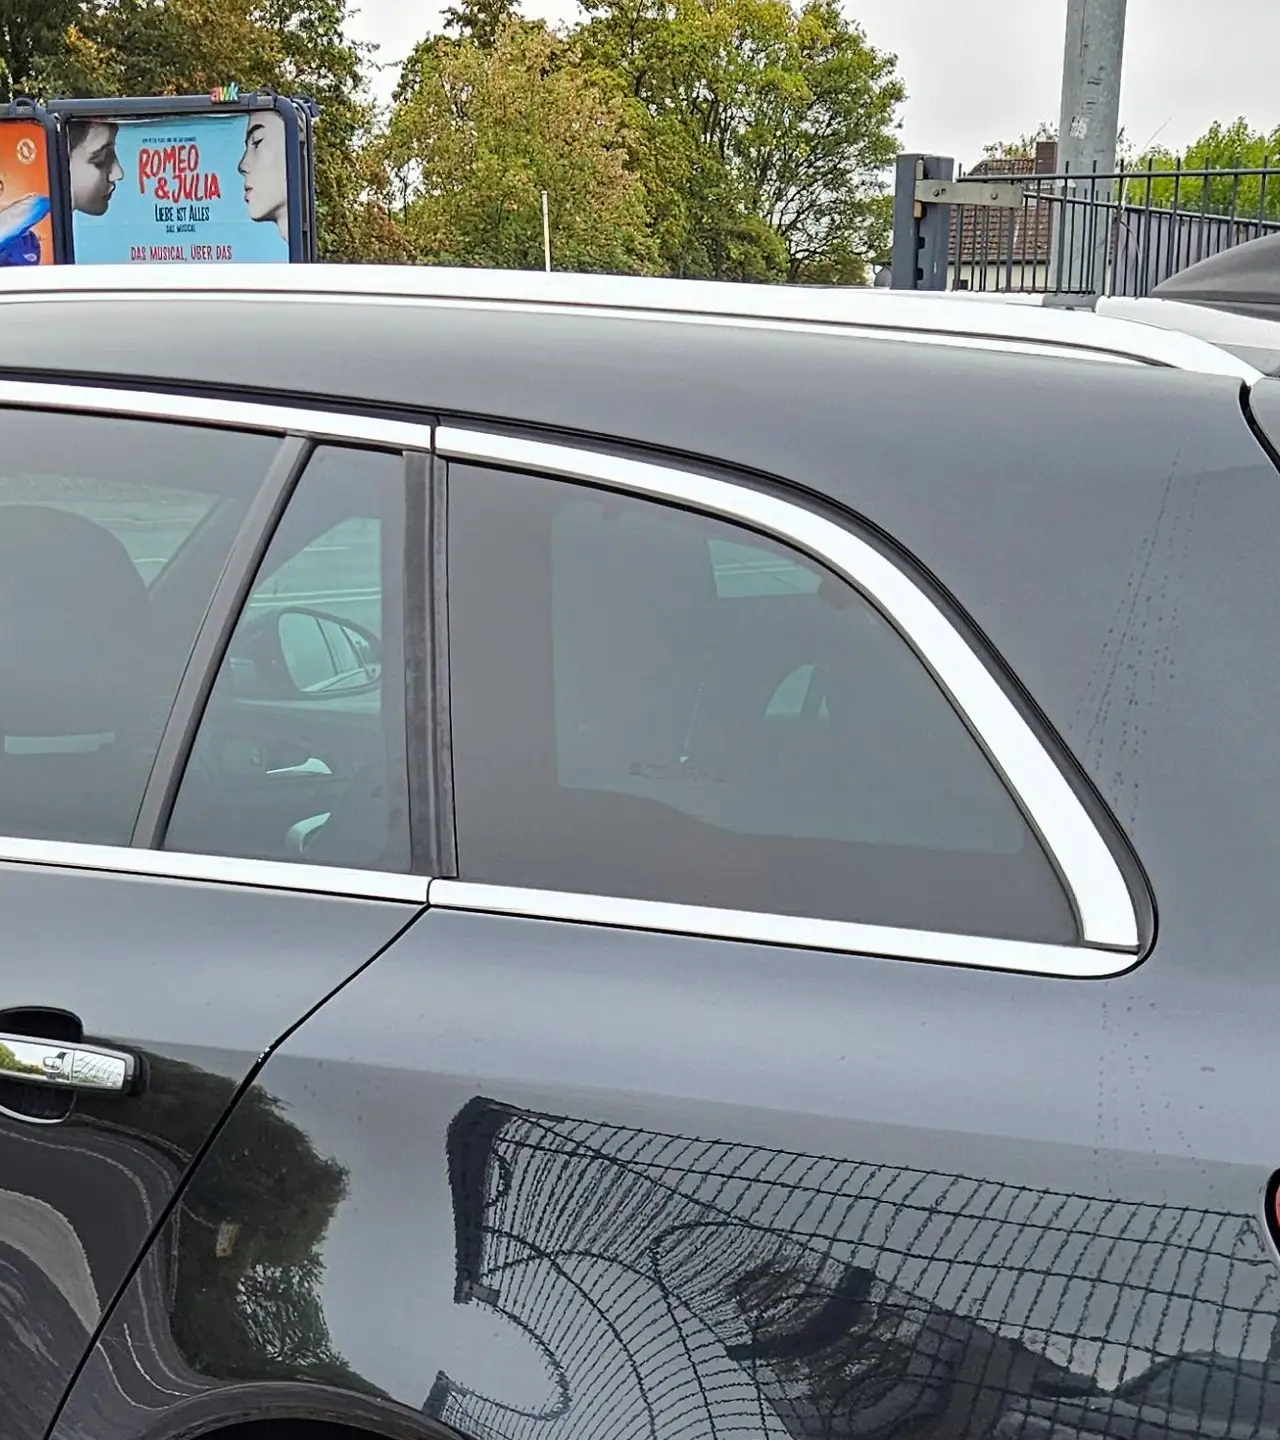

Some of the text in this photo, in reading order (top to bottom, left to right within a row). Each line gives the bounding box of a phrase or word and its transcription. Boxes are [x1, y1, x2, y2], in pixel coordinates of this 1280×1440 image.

[138, 144, 199, 194] ROMEO
[154, 172, 221, 204] & JULIA
[130, 246, 146, 261] DAS
[190, 244, 213, 260] ÜBER
[216, 245, 232, 260] DAS
